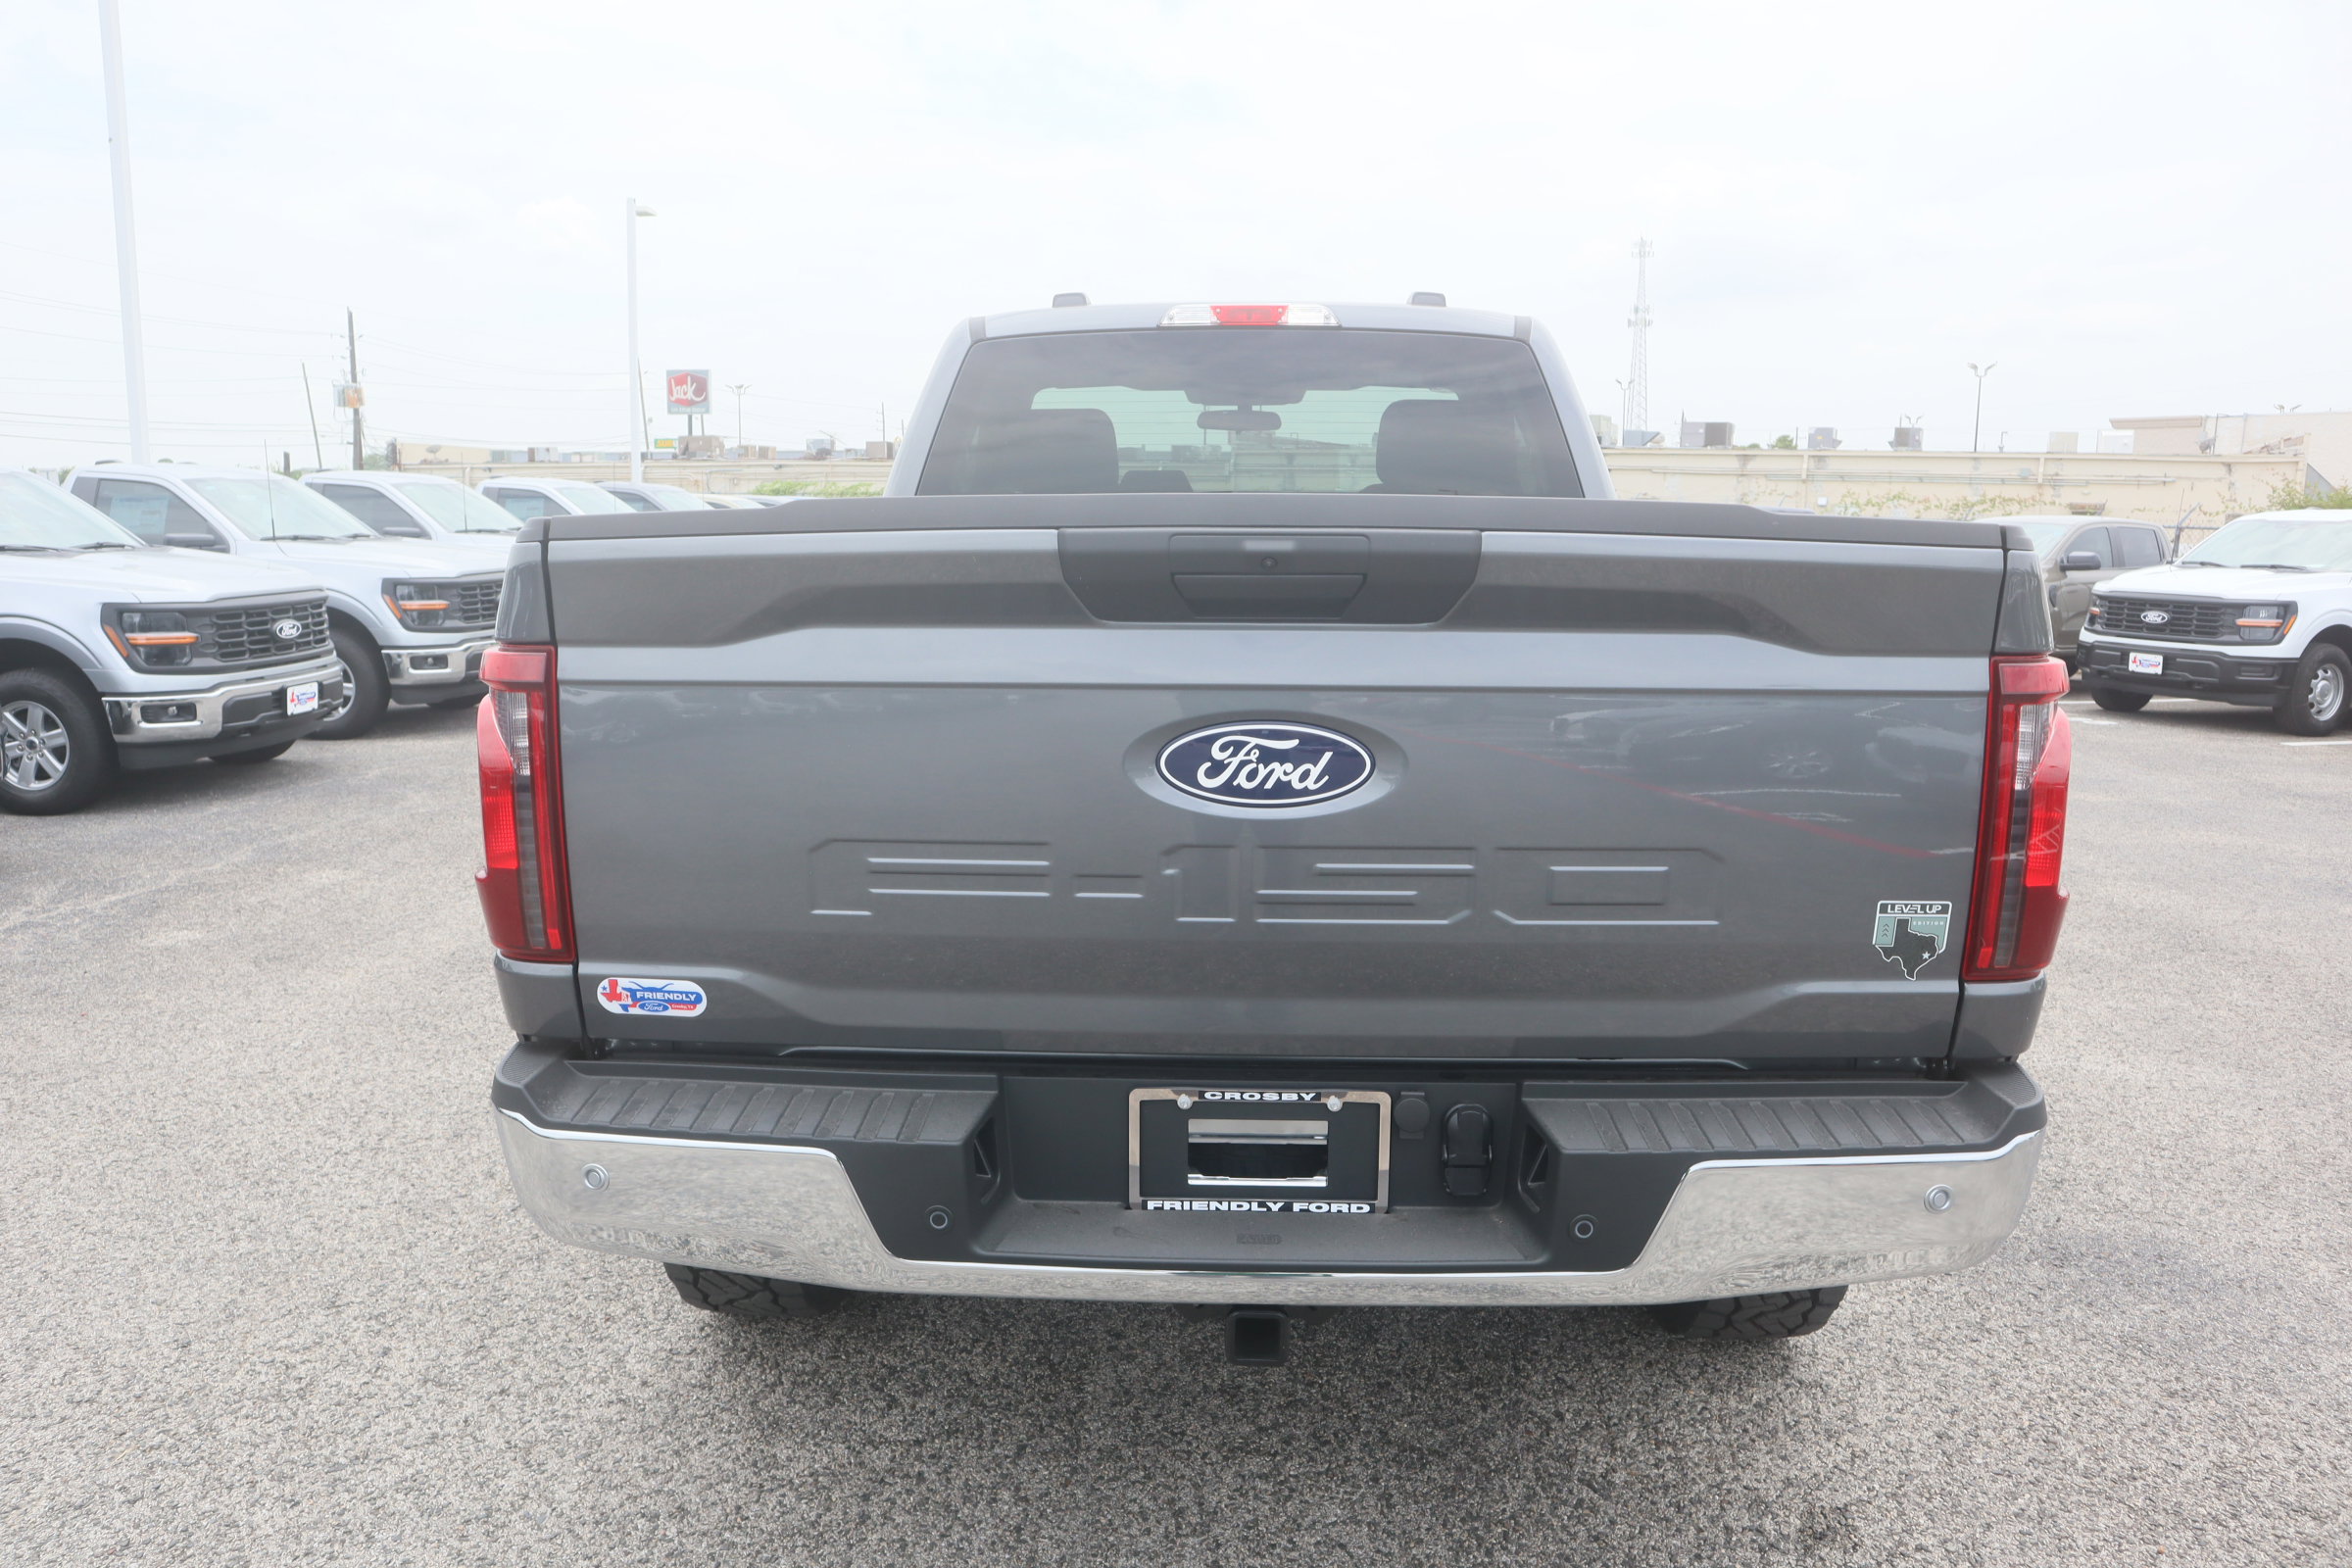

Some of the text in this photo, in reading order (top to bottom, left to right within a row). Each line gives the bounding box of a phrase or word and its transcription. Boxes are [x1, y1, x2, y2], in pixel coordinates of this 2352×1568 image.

[669, 375, 706, 401] Jack
[1197, 735, 1333, 790] Ford
[1887, 904, 1941, 913] LEVEL UP
[636, 991, 697, 1002] FRIENDLY
[644, 1003, 663, 1011] Ford
[1203, 1092, 1316, 1102] CROSBY
[1147, 1200, 1371, 1213] FRIENDLY FORD
